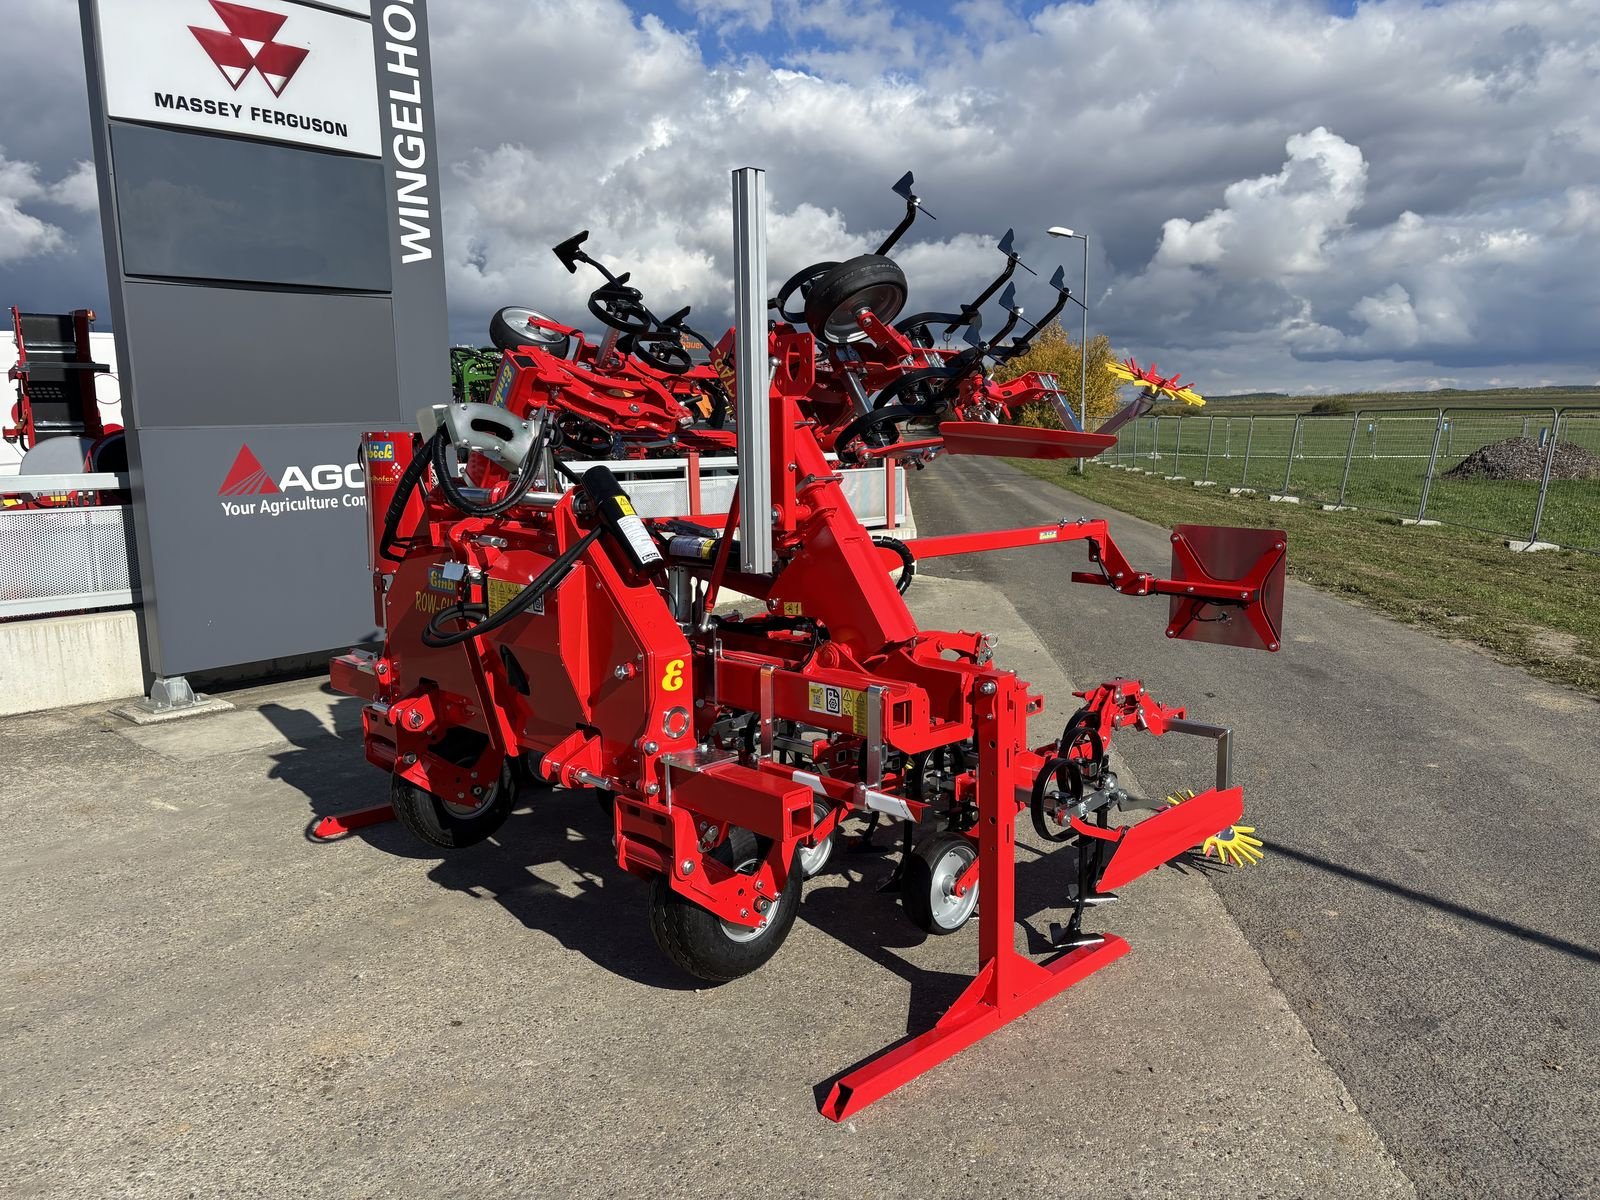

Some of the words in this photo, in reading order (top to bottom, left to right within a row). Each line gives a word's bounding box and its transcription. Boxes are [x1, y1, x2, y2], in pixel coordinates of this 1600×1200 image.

[154, 92, 243, 119] MASSEY
[250, 107, 348, 138] FERGUSON
[382, 0, 433, 264] WINGELHO
[278, 463, 366, 493] AGC
[221, 501, 256, 516] Your
[259, 496, 339, 516] Agriculture
[430, 570, 456, 591] Einb
[661, 659, 685, 692] E
